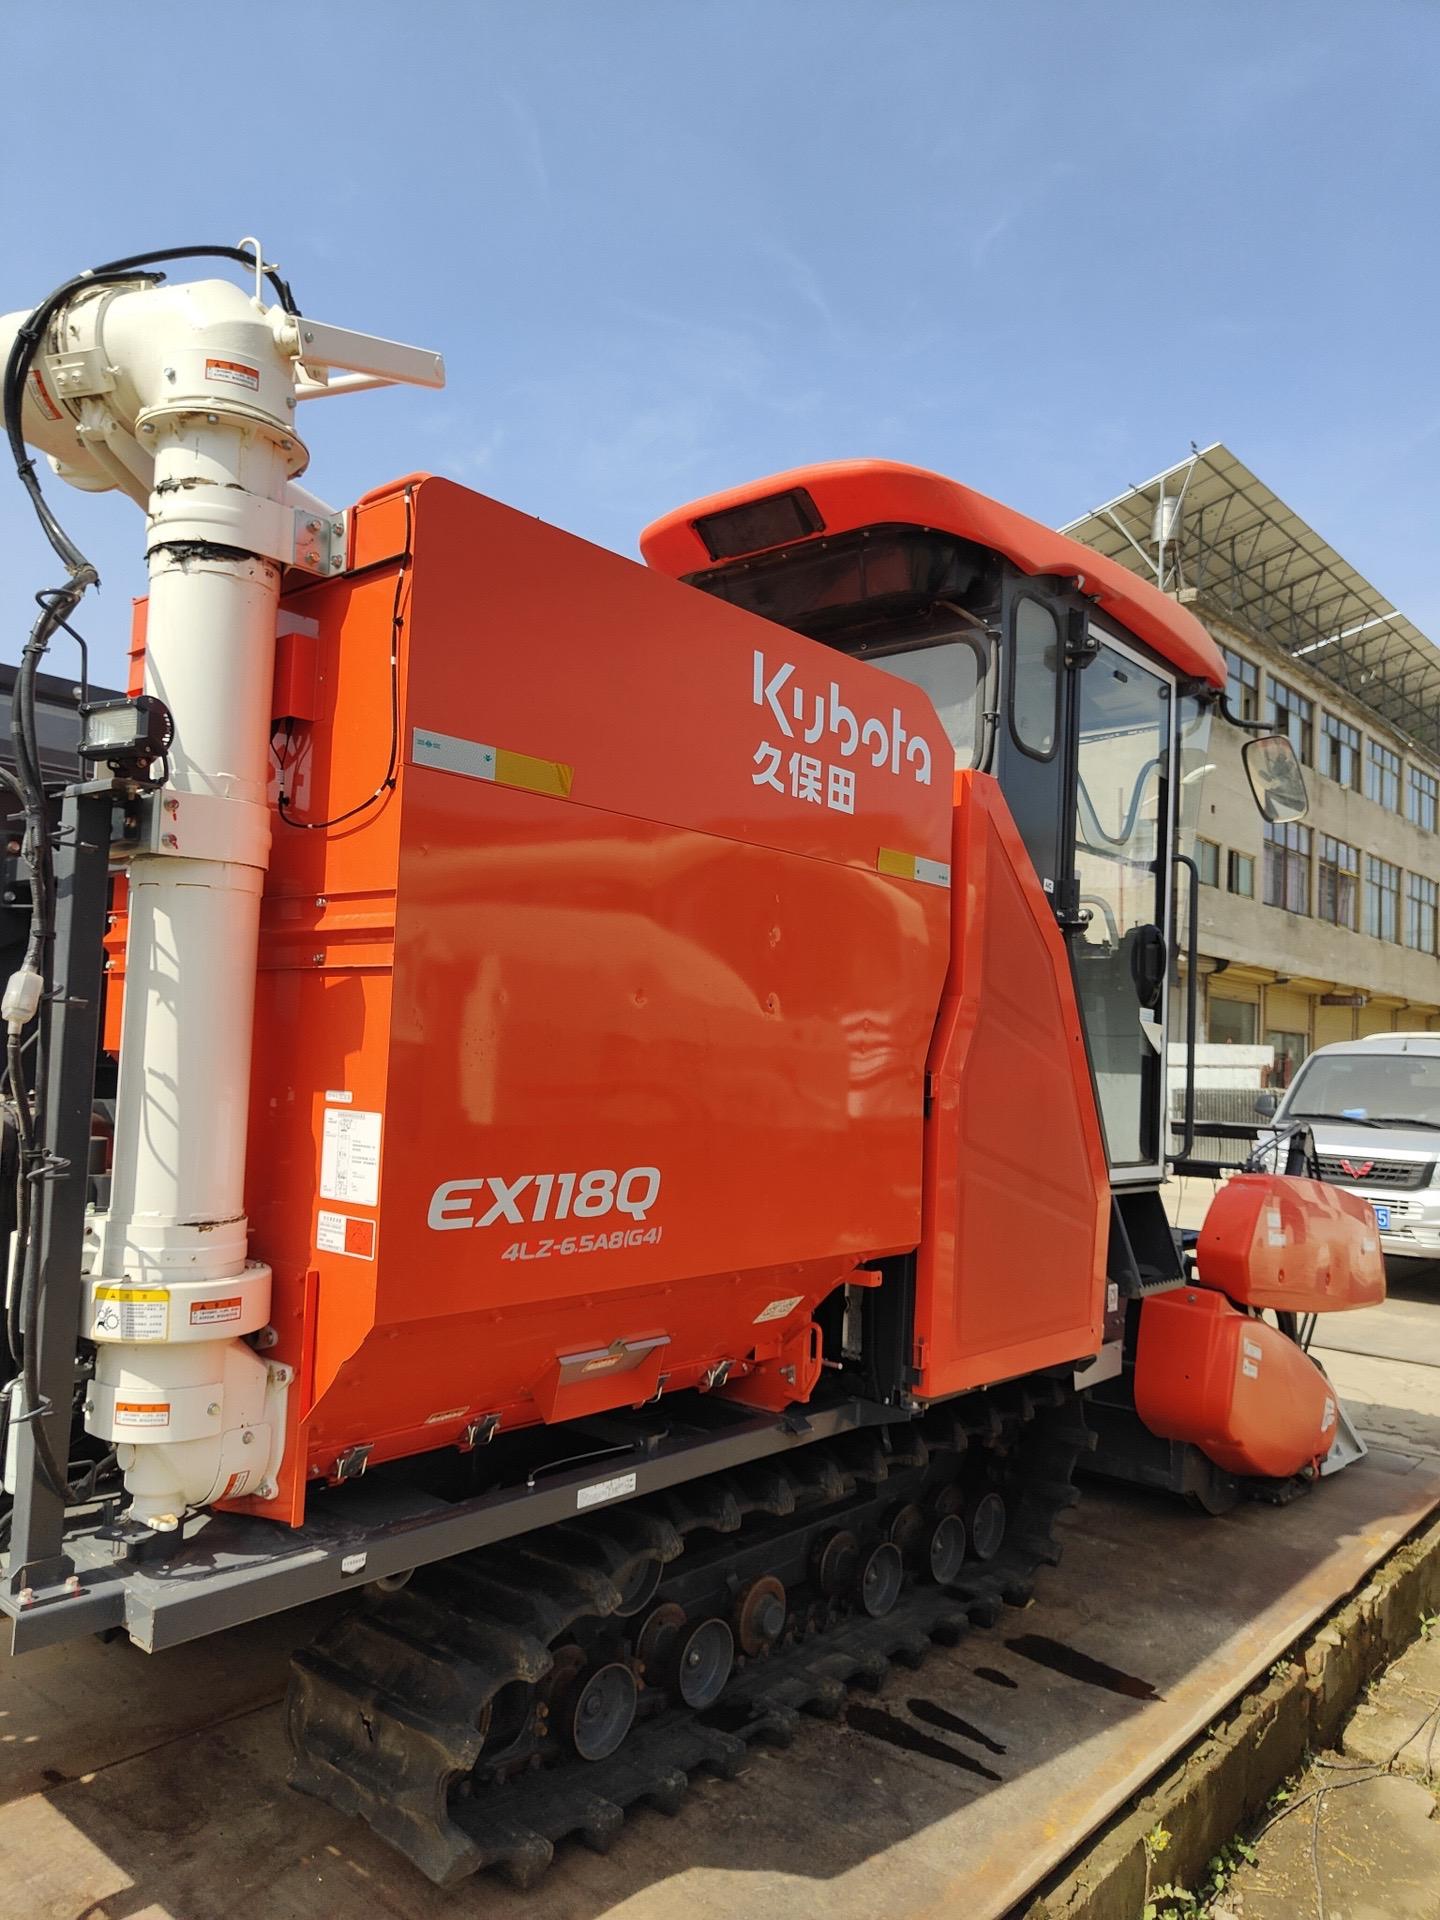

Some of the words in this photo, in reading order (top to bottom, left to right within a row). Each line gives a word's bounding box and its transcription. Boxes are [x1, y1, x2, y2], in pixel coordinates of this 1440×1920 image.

[753, 650, 931, 785] Kubota
[752, 741, 856, 815] 久保田
[427, 1166, 661, 1231] EX118Q
[501, 1226, 663, 1262] 4LZ-6.5A8(G4)
